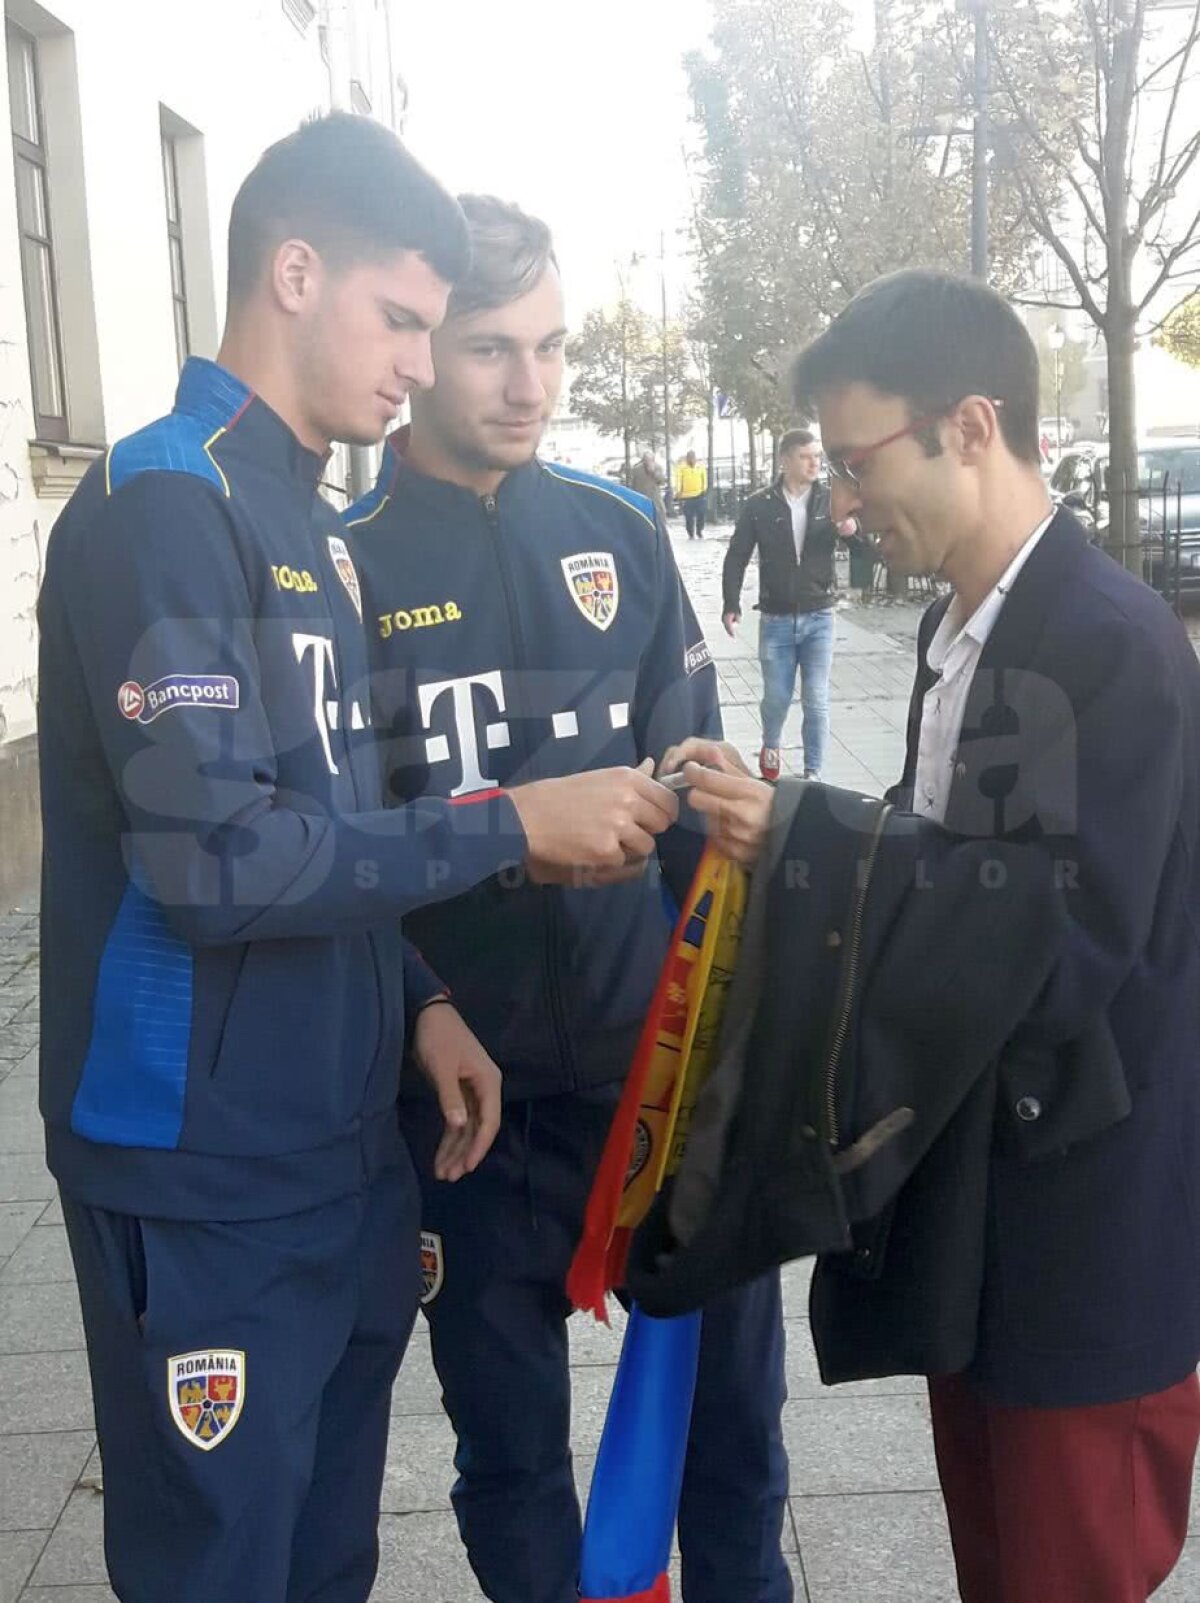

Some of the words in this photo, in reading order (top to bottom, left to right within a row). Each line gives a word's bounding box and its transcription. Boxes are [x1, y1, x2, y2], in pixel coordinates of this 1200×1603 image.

[147, 683, 229, 709] Bancpost
[418, 670, 507, 797] T
[177, 1354, 237, 1377] ROMÂNIA
